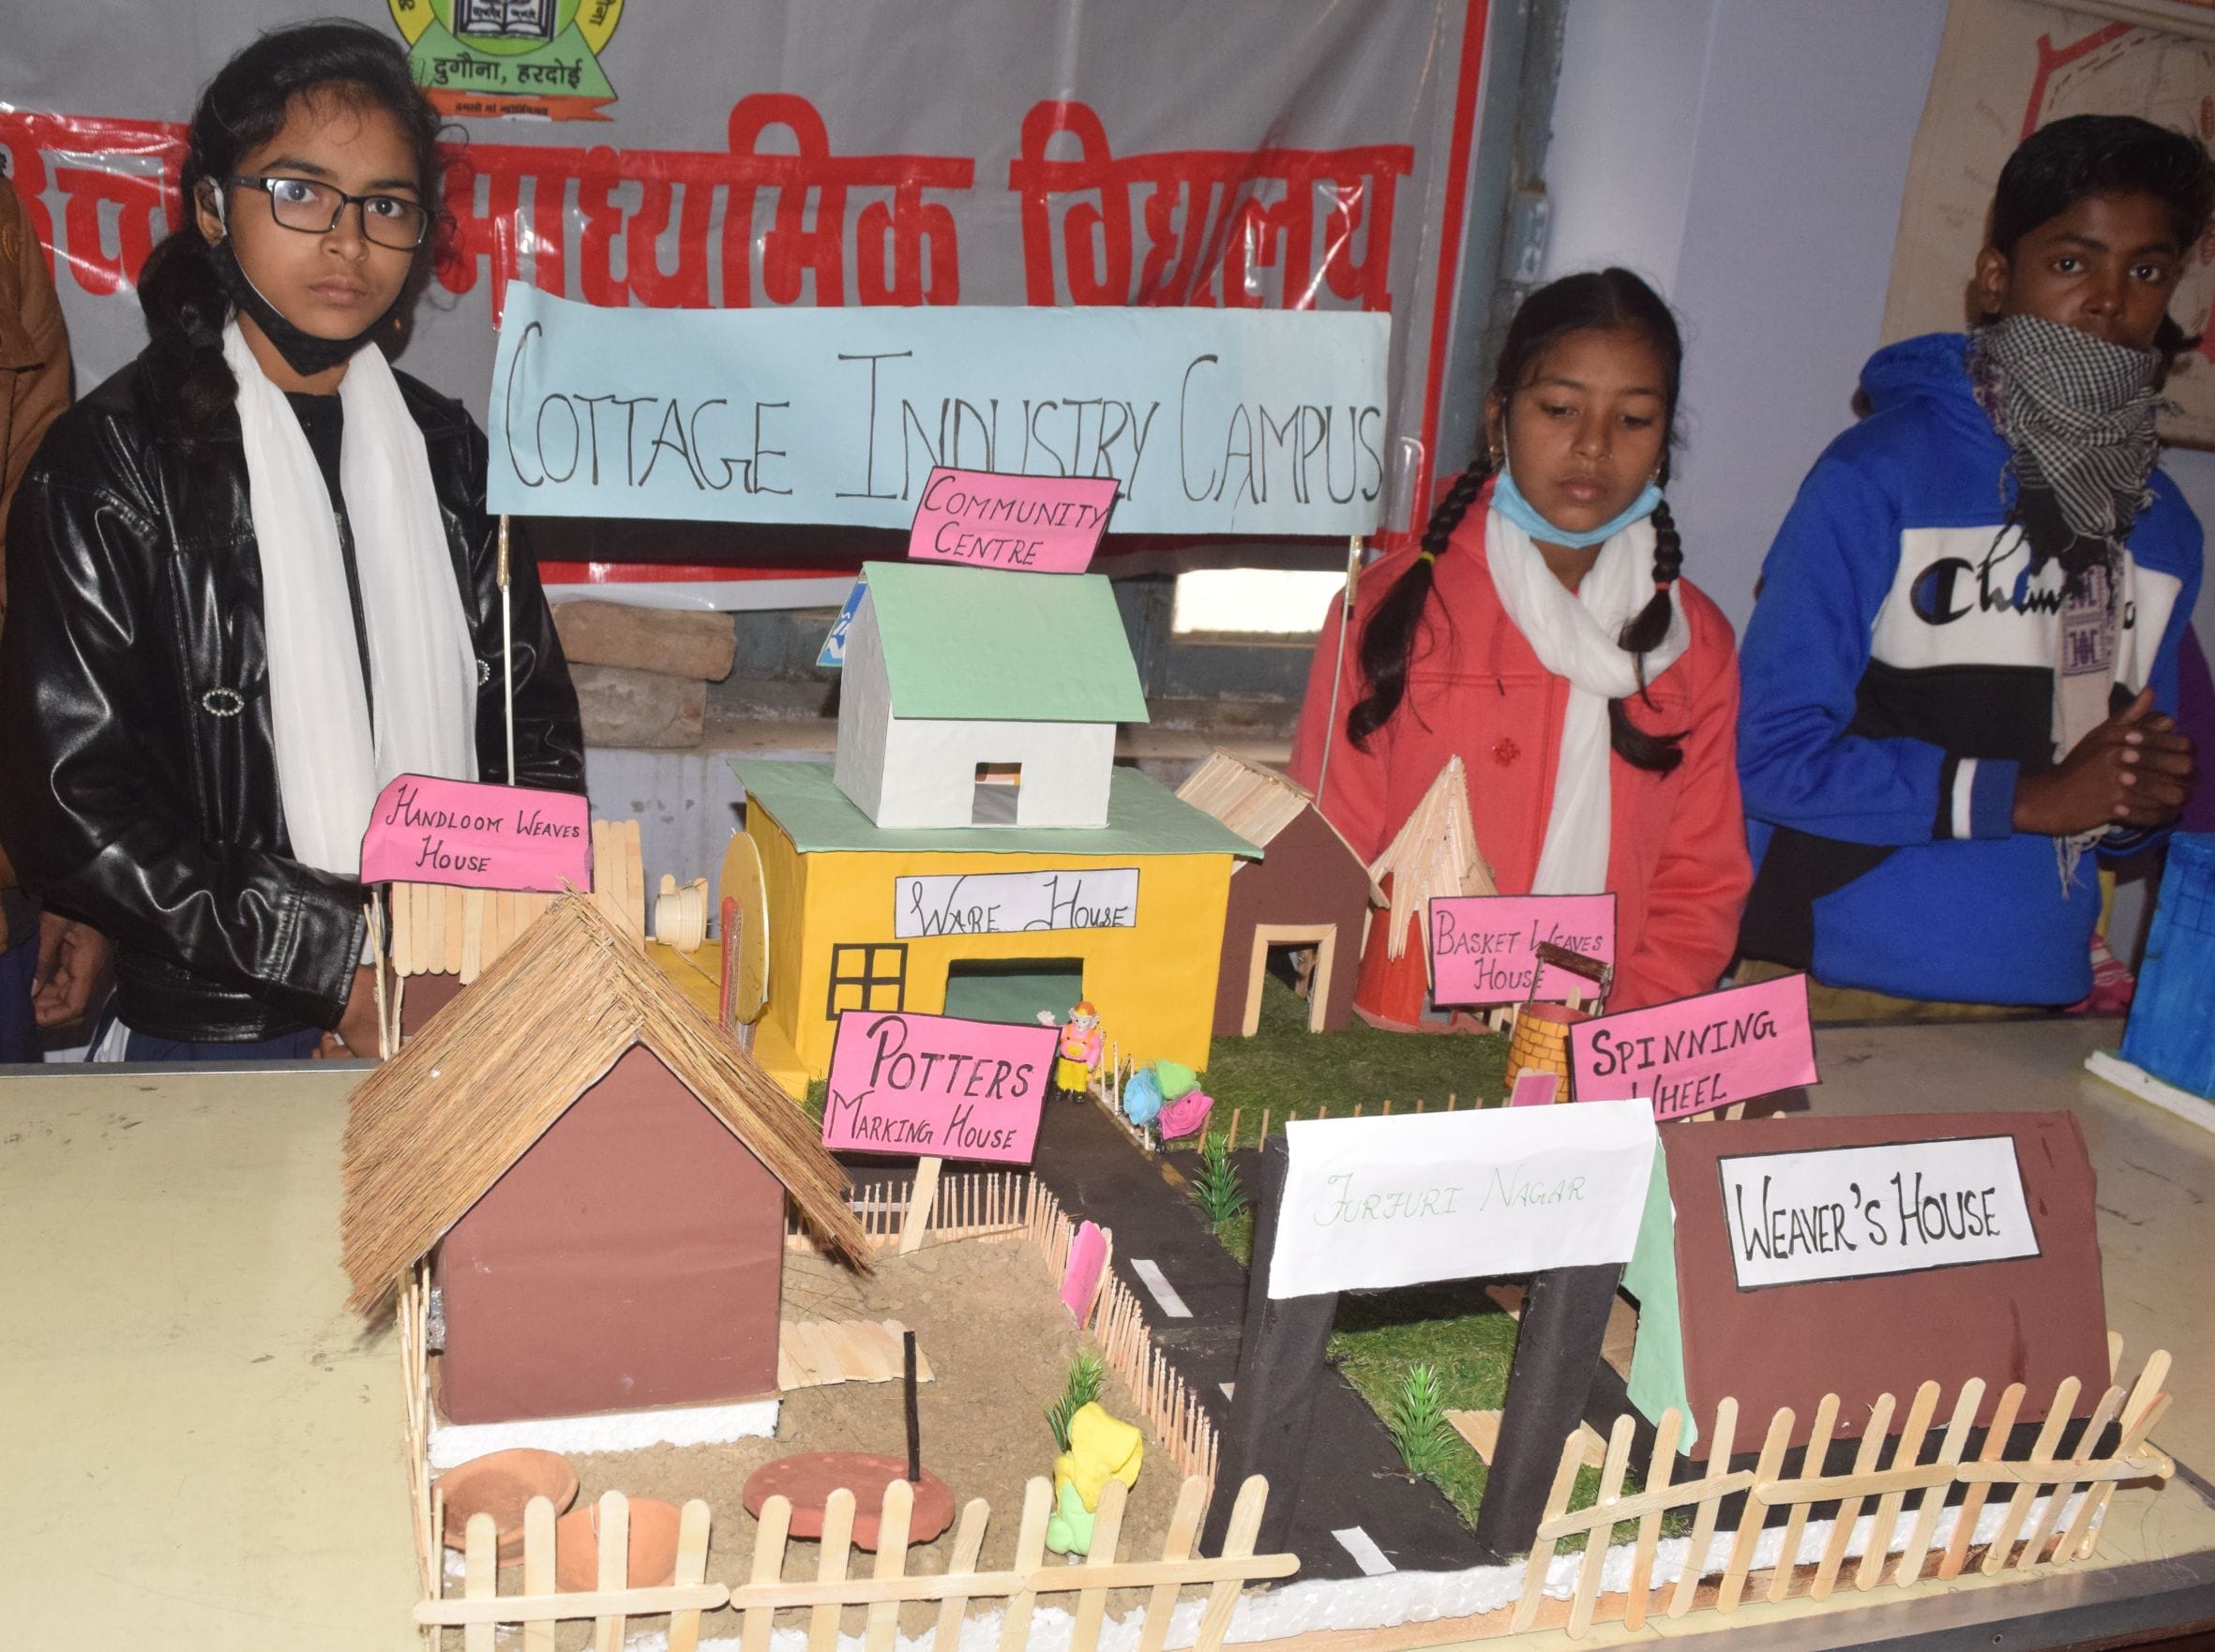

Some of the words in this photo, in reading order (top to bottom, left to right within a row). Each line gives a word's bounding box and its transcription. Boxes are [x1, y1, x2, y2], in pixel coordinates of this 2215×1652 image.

[517, 58, 582, 89] हरदोई
[505, 321, 793, 494] COTTAGE
[1181, 354, 1383, 506] CAMPUS
[924, 475, 1109, 530] COMMUNITY
[934, 521, 1044, 565] CENTRE
[385, 784, 504, 833] HANDLOOM
[517, 809, 580, 838] WEAVES
[415, 834, 492, 873] HOUSE
[910, 876, 1002, 936] WARE
[1023, 875, 1128, 931] HOUSE
[1436, 909, 1521, 955] BASKET
[866, 1015, 1033, 1100] POTTERS
[1590, 1010, 1777, 1076] SPINNING
[827, 1089, 934, 1145] MARKING
[942, 1104, 1017, 1150] HOUSE
[1479, 1164, 1587, 1212] NAGAR
[1735, 1175, 1888, 1261] WEAVER'S
[1891, 1171, 2001, 1246] HOUSE
